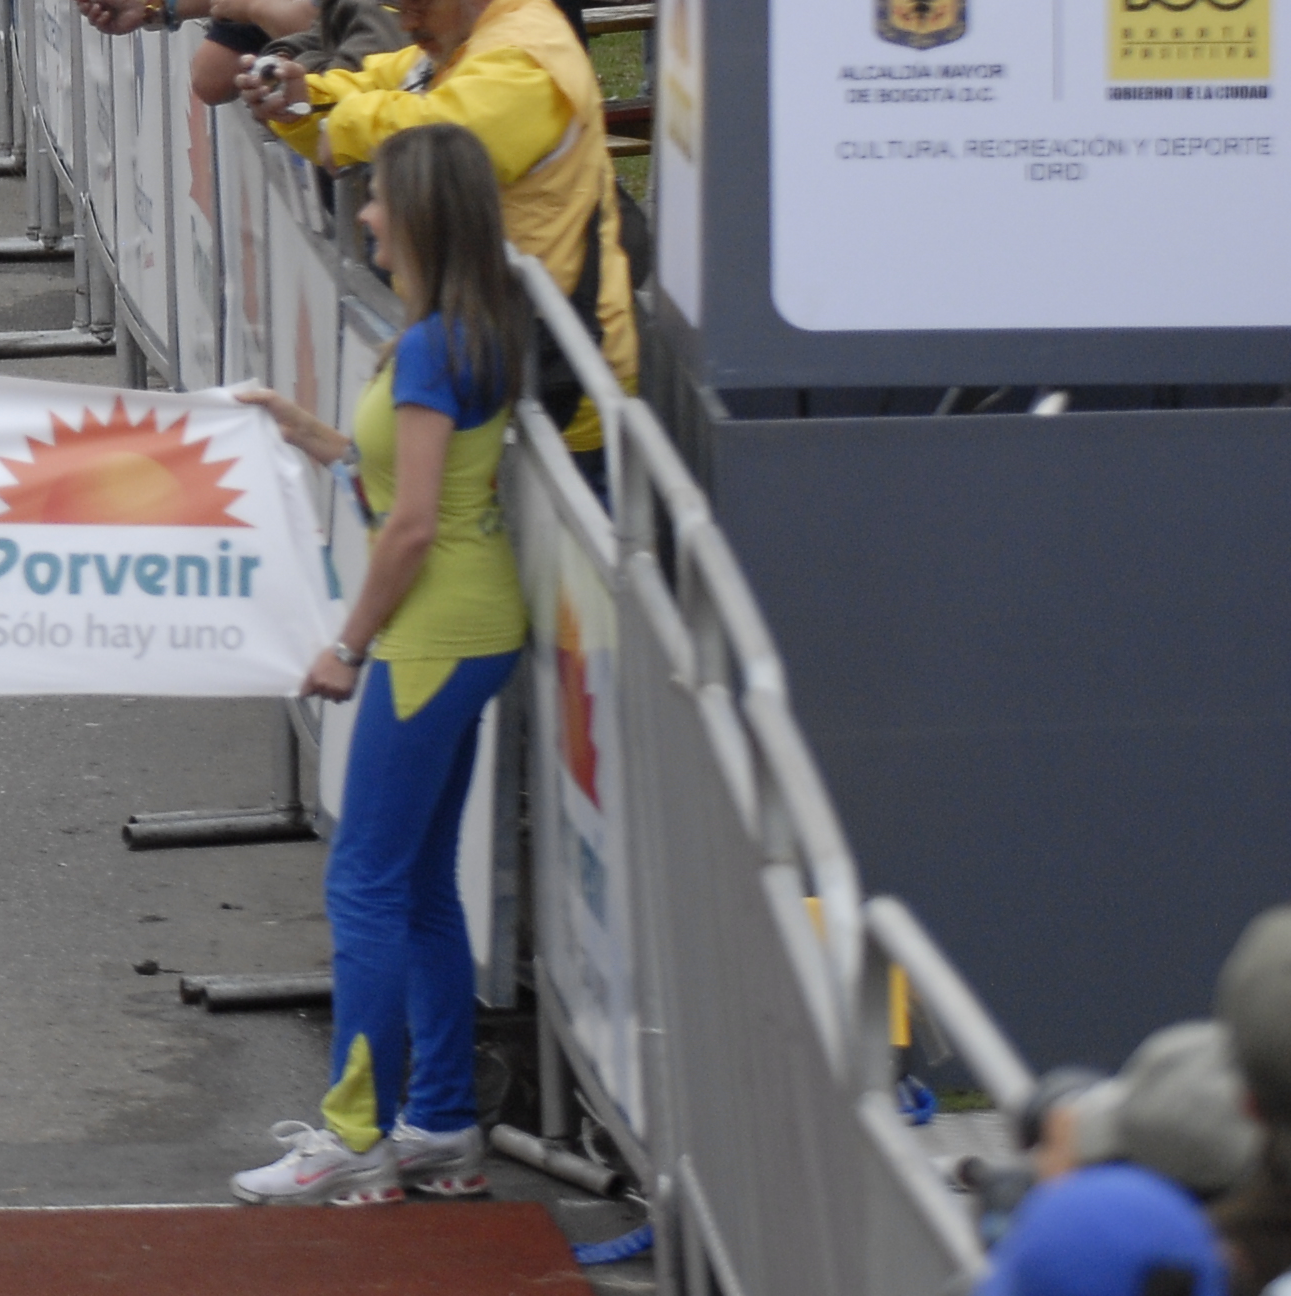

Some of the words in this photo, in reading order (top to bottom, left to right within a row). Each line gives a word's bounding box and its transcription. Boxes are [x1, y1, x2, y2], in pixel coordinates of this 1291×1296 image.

[1130, 137, 1147, 156] Y
[1152, 135, 1274, 156] DEPORTE
[84, 612, 157, 661] hay
[167, 624, 245, 652] uno
